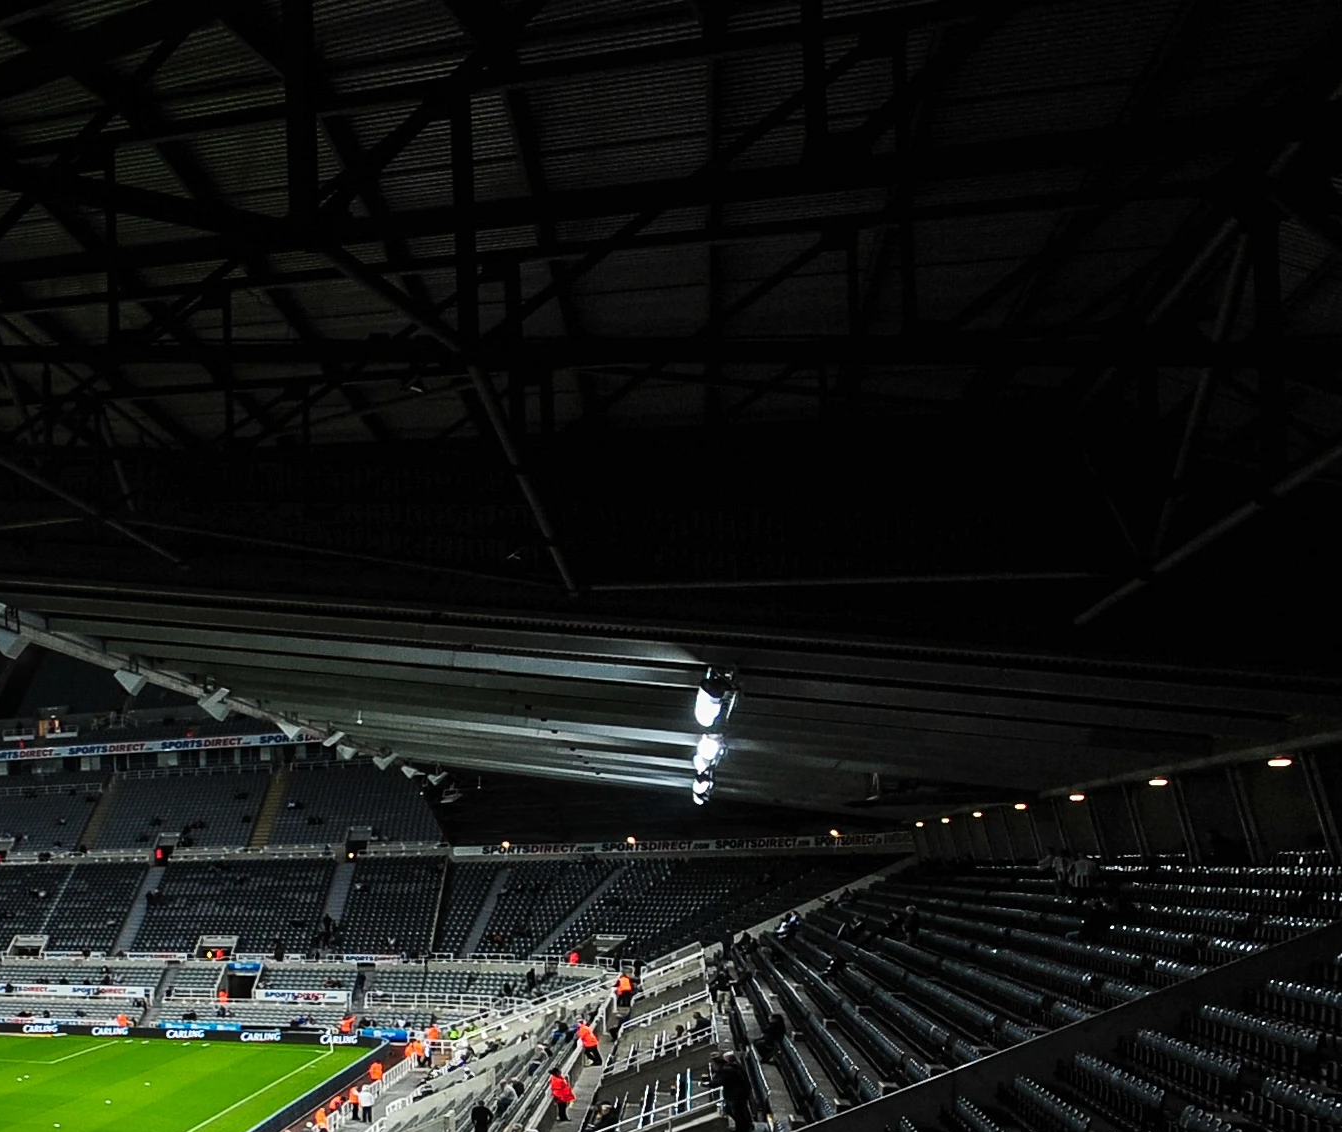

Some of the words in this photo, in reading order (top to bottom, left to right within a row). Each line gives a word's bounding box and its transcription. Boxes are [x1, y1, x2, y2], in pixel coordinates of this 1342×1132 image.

[22, 1023, 58, 1034] CARLING
[91, 1026, 129, 1036] CARLING
[166, 1029, 205, 1039] CARLING
[240, 1031, 281, 1042] CARLING
[319, 1033, 358, 1046] CARLING
